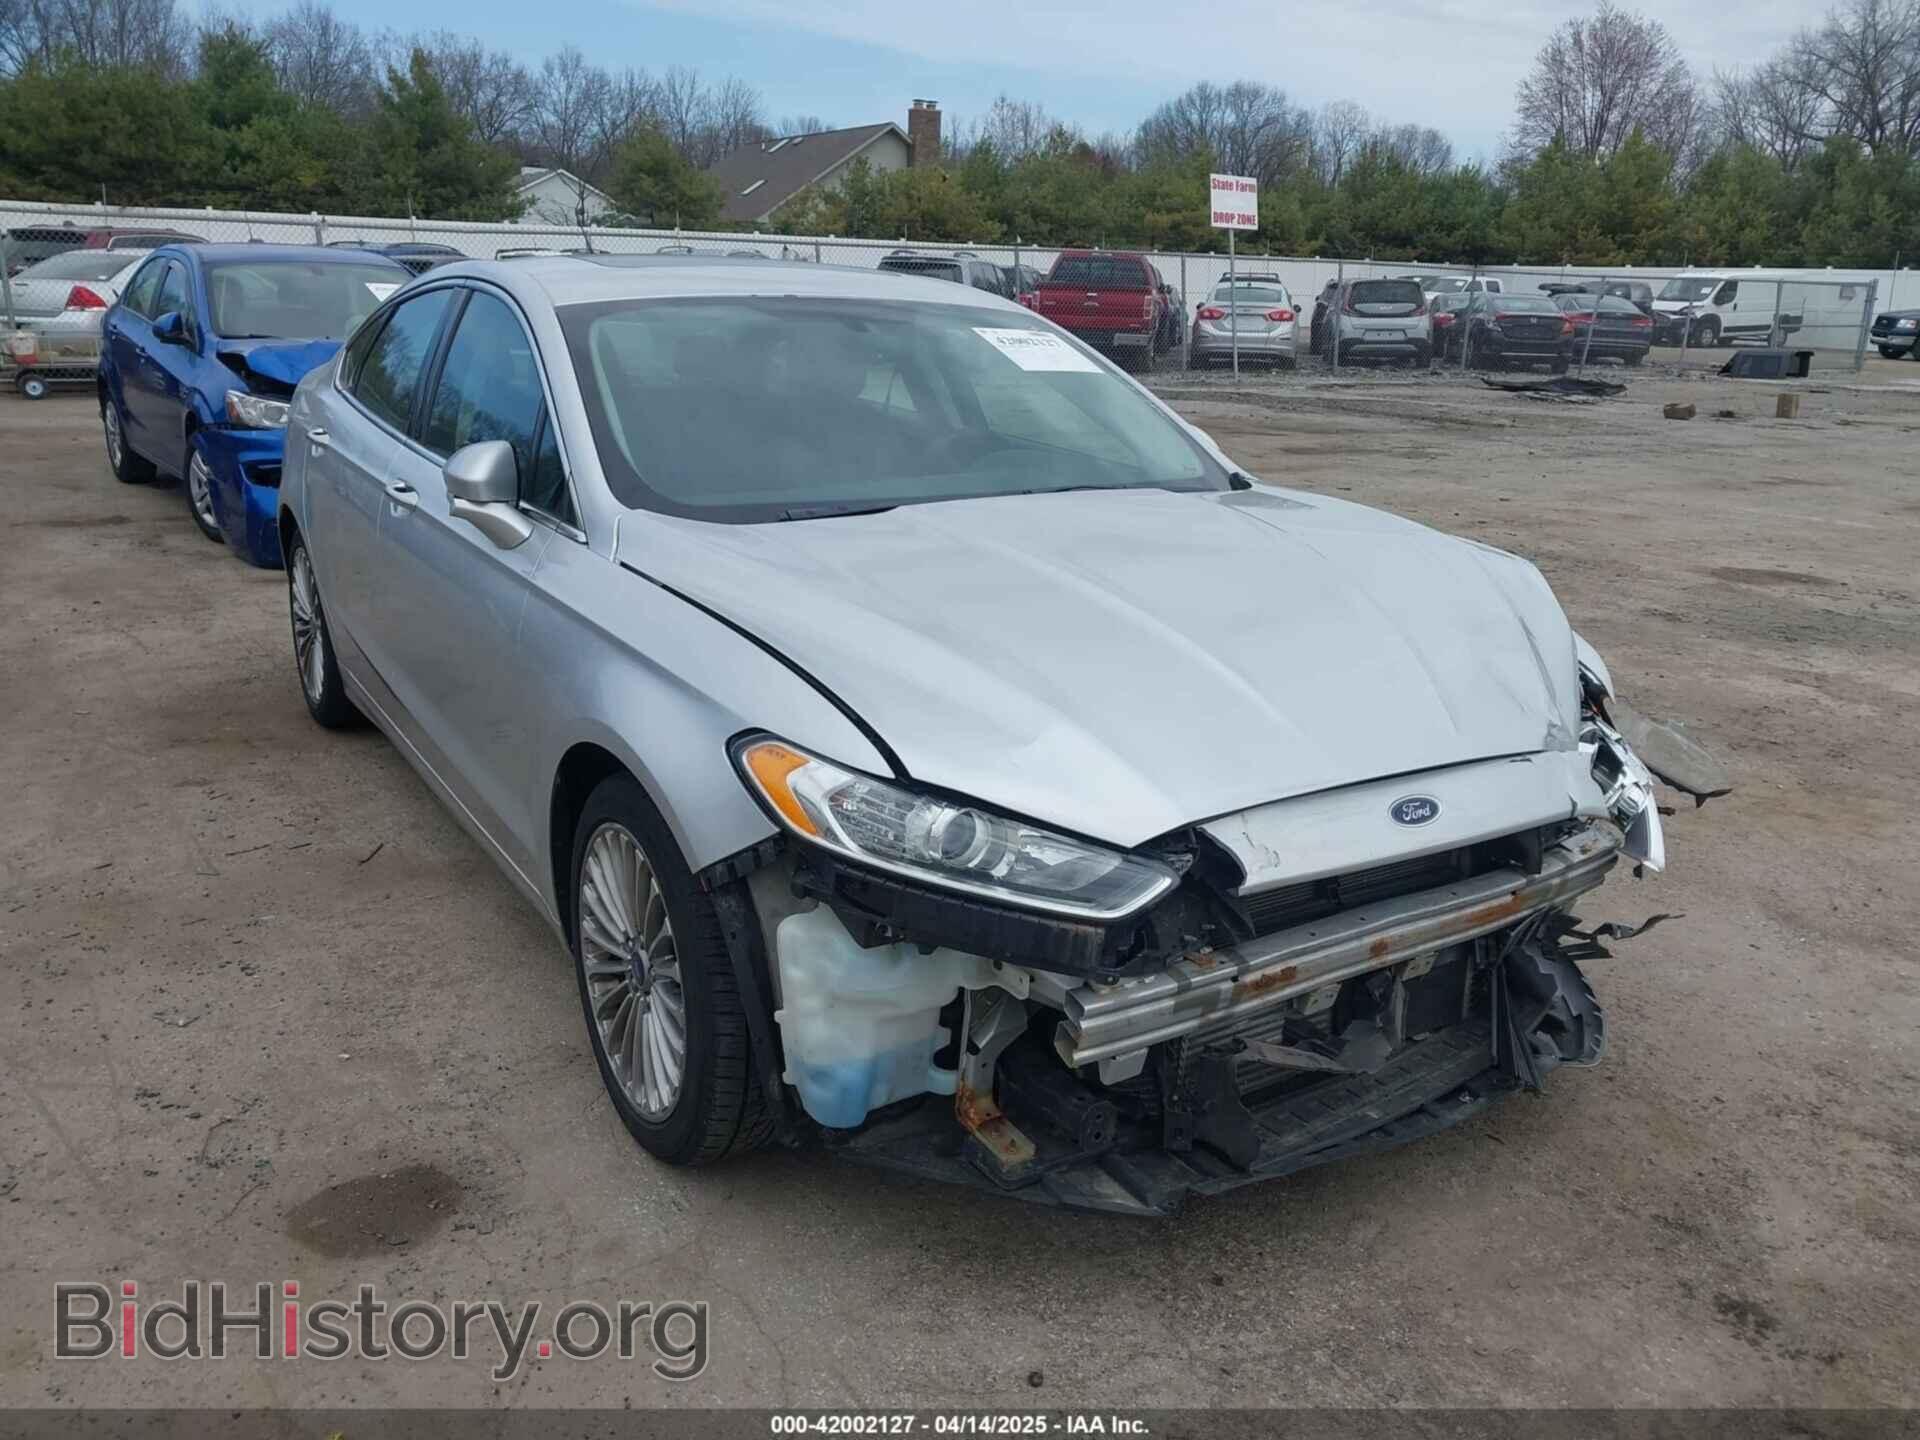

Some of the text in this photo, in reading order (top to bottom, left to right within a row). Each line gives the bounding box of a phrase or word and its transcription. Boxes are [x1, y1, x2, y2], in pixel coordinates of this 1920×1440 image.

[1212, 178, 1234, 191] State
[1213, 211, 1257, 226] DROP ZONE
[1402, 801, 1431, 821] Ford
